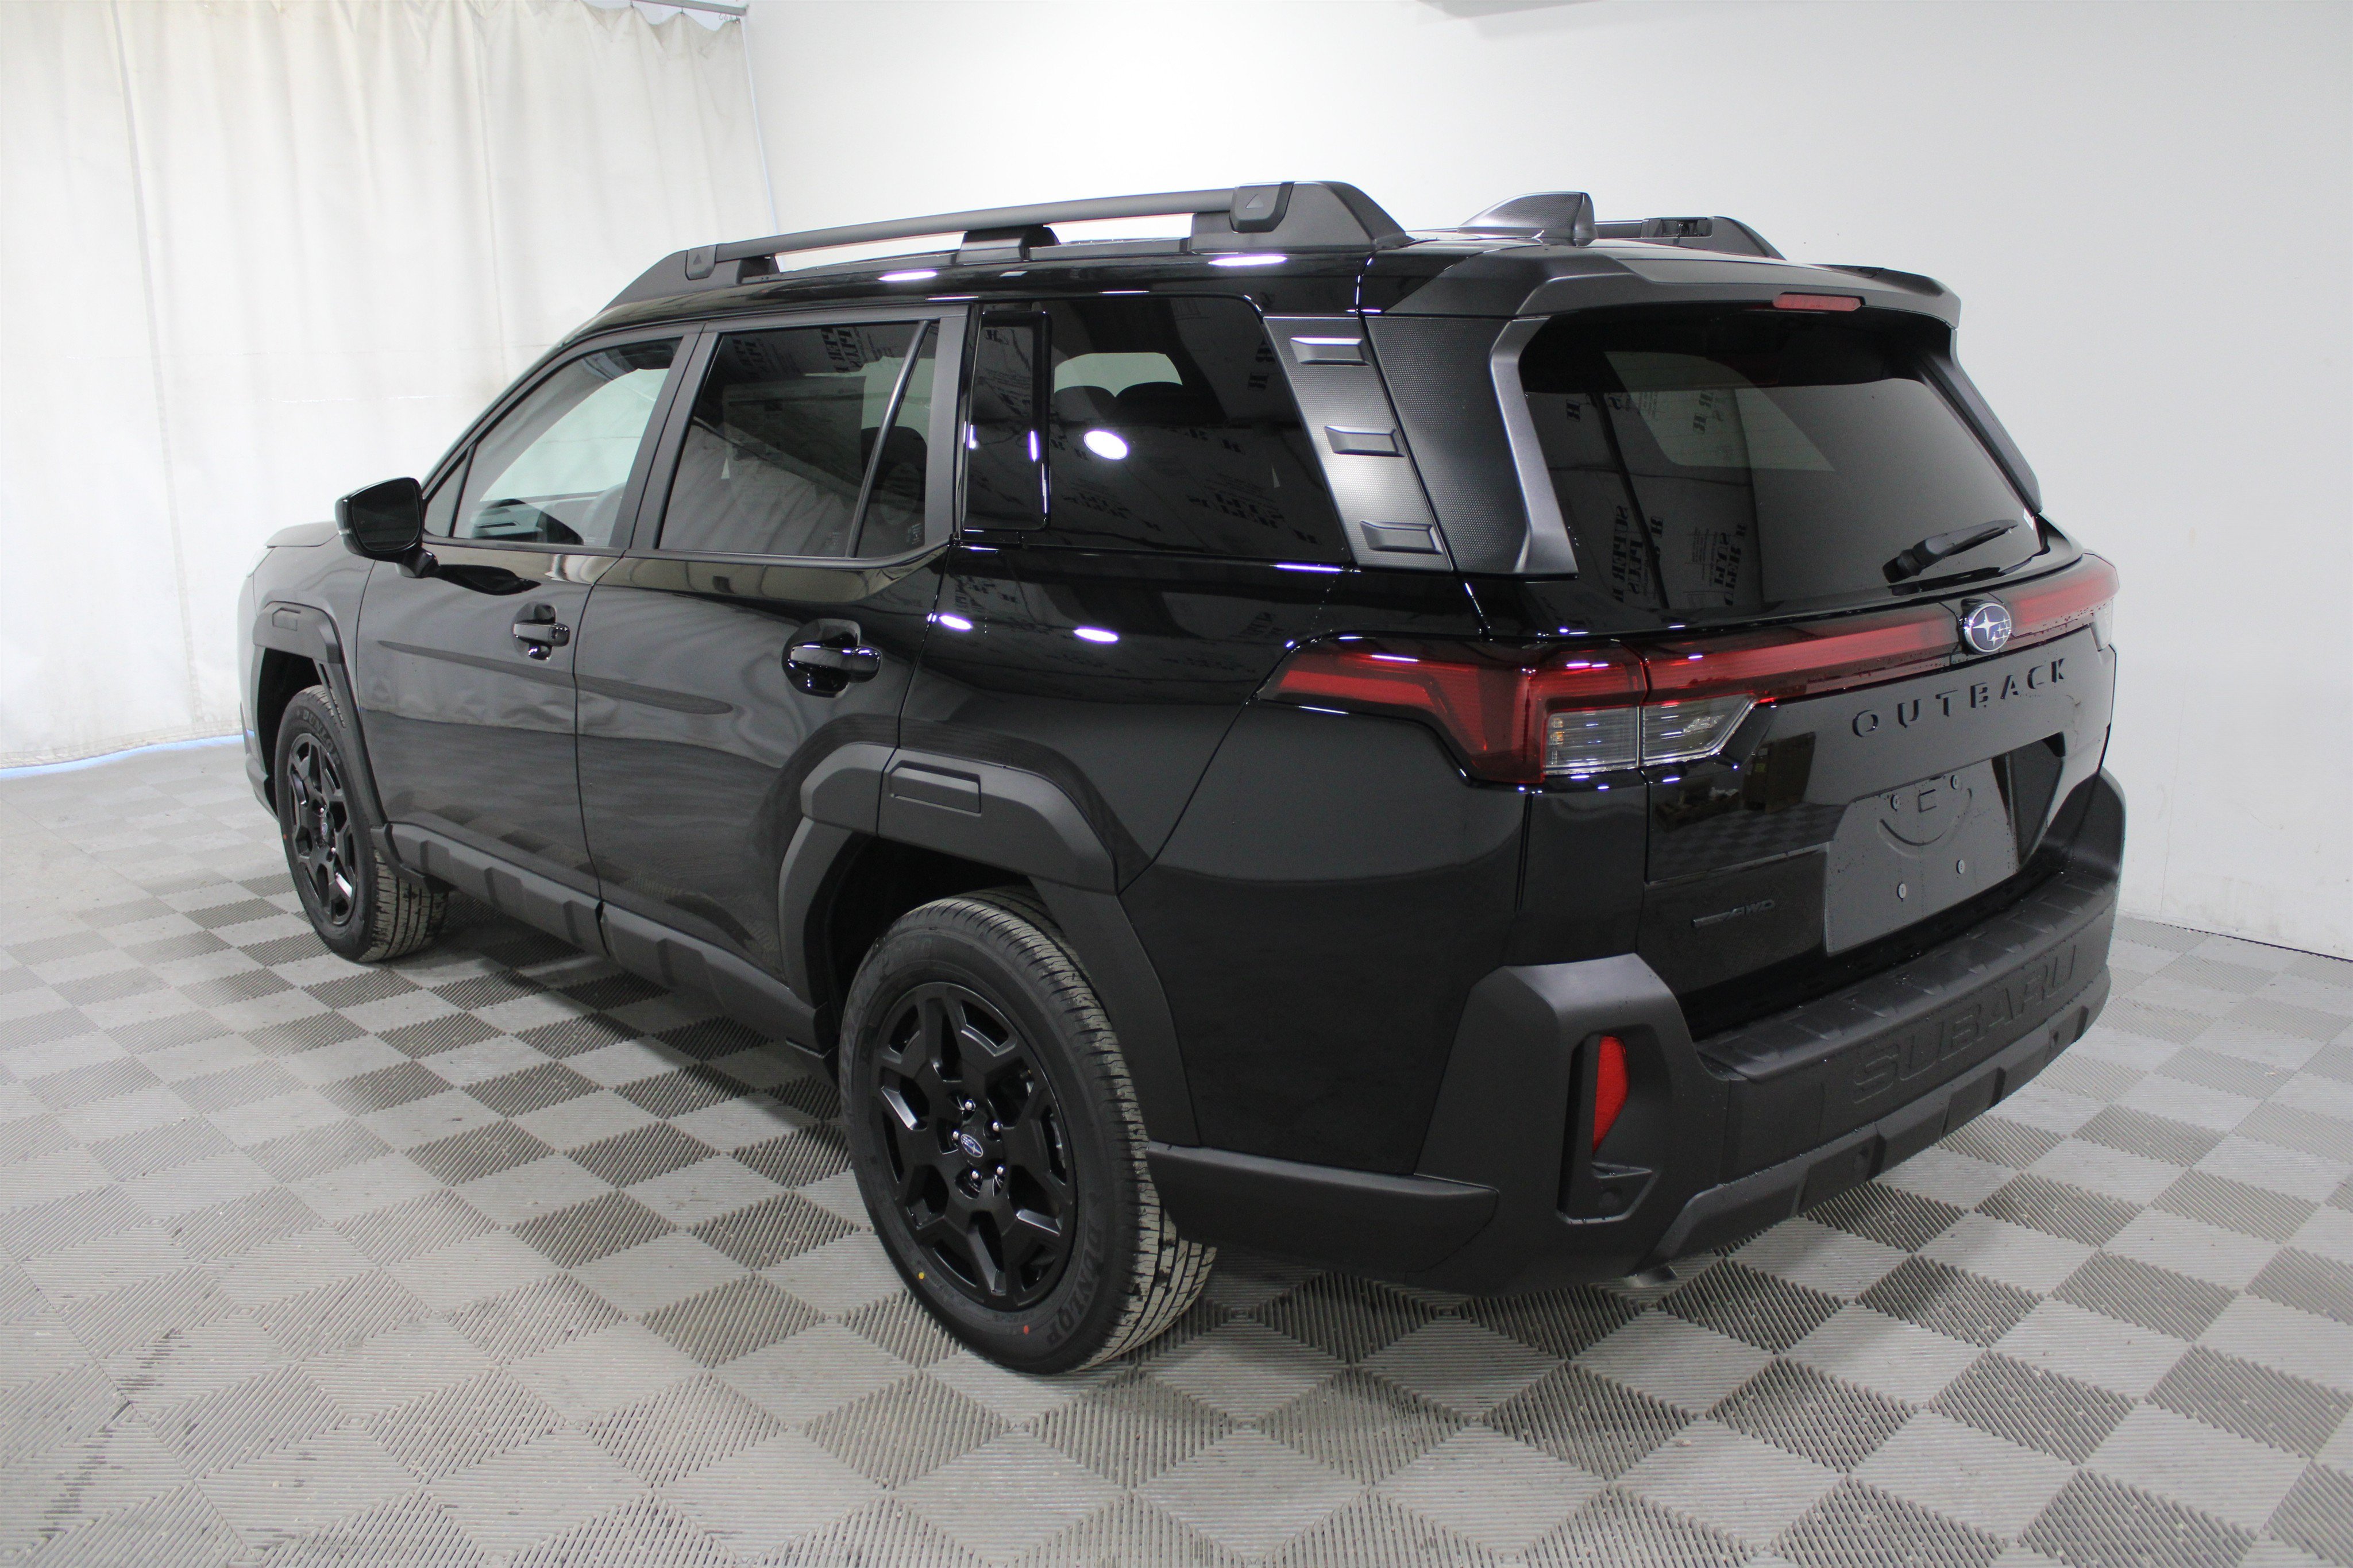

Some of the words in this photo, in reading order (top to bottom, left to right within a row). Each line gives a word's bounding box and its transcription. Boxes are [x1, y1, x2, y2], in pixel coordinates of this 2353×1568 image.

[302, 708, 341, 766] DUNLOP
[1851, 657, 2066, 738] OUTBACK
[1725, 898, 1776, 921] AWD
[1851, 944, 2076, 1105] SUBARU
[1046, 1221, 1105, 1346] DUNLOP
